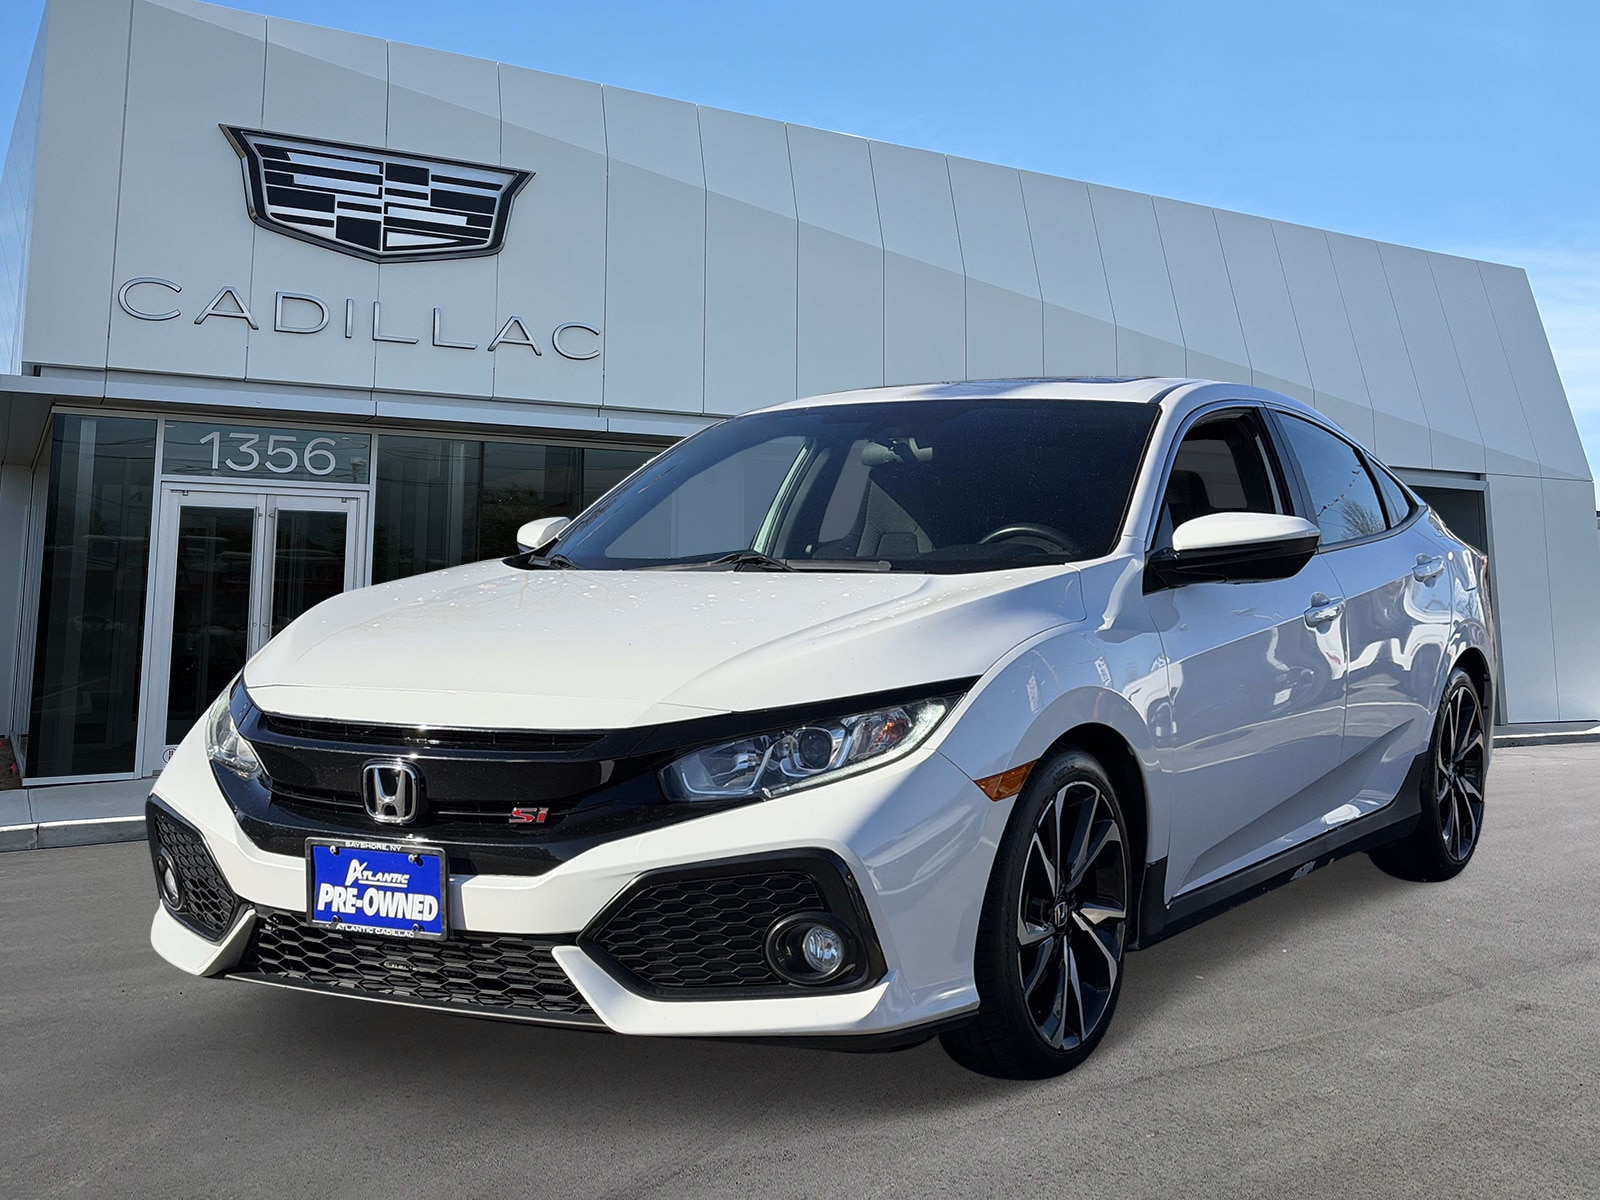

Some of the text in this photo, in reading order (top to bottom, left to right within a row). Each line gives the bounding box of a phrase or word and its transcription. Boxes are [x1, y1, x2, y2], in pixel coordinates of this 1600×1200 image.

[117, 276, 601, 361] CADILLAC
[199, 430, 337, 476] 1356
[390, 844, 402, 852] NY
[317, 883, 439, 922] PRE-OWNED
[335, 923, 415, 938] ATLANTIC CADILLAC
